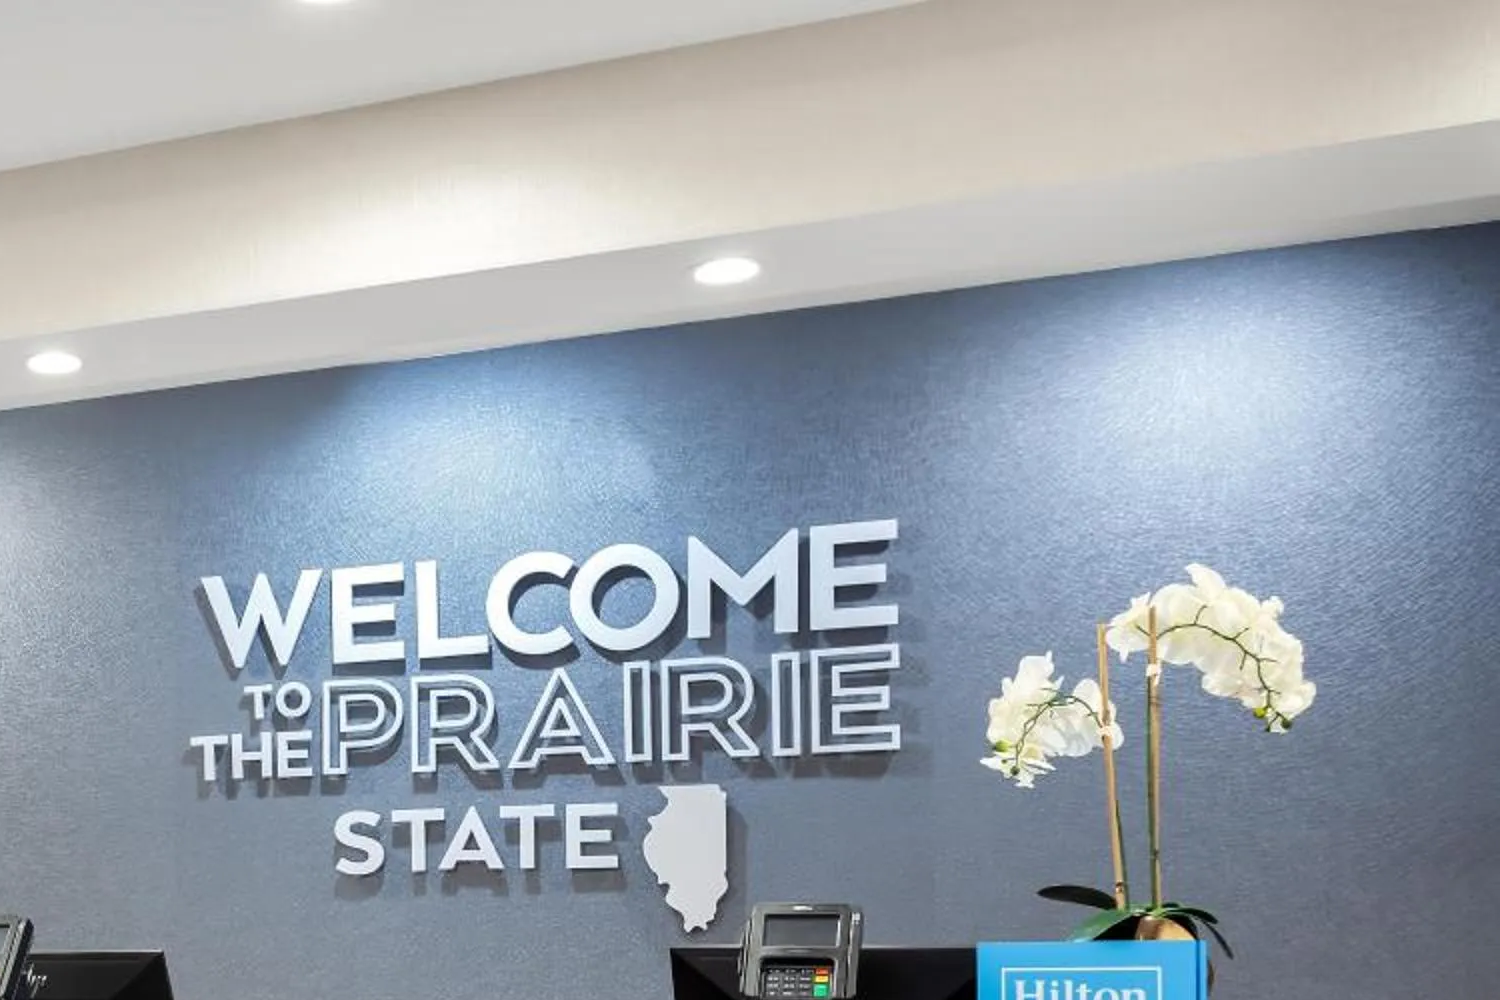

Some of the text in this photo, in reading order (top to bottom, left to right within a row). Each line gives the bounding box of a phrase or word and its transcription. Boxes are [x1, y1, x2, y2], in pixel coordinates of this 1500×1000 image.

[201, 519, 900, 669] WELCOME
[190, 642, 901, 781] THE PRAIRIE
[243, 681, 311, 719] TO
[334, 803, 620, 876] STATE
